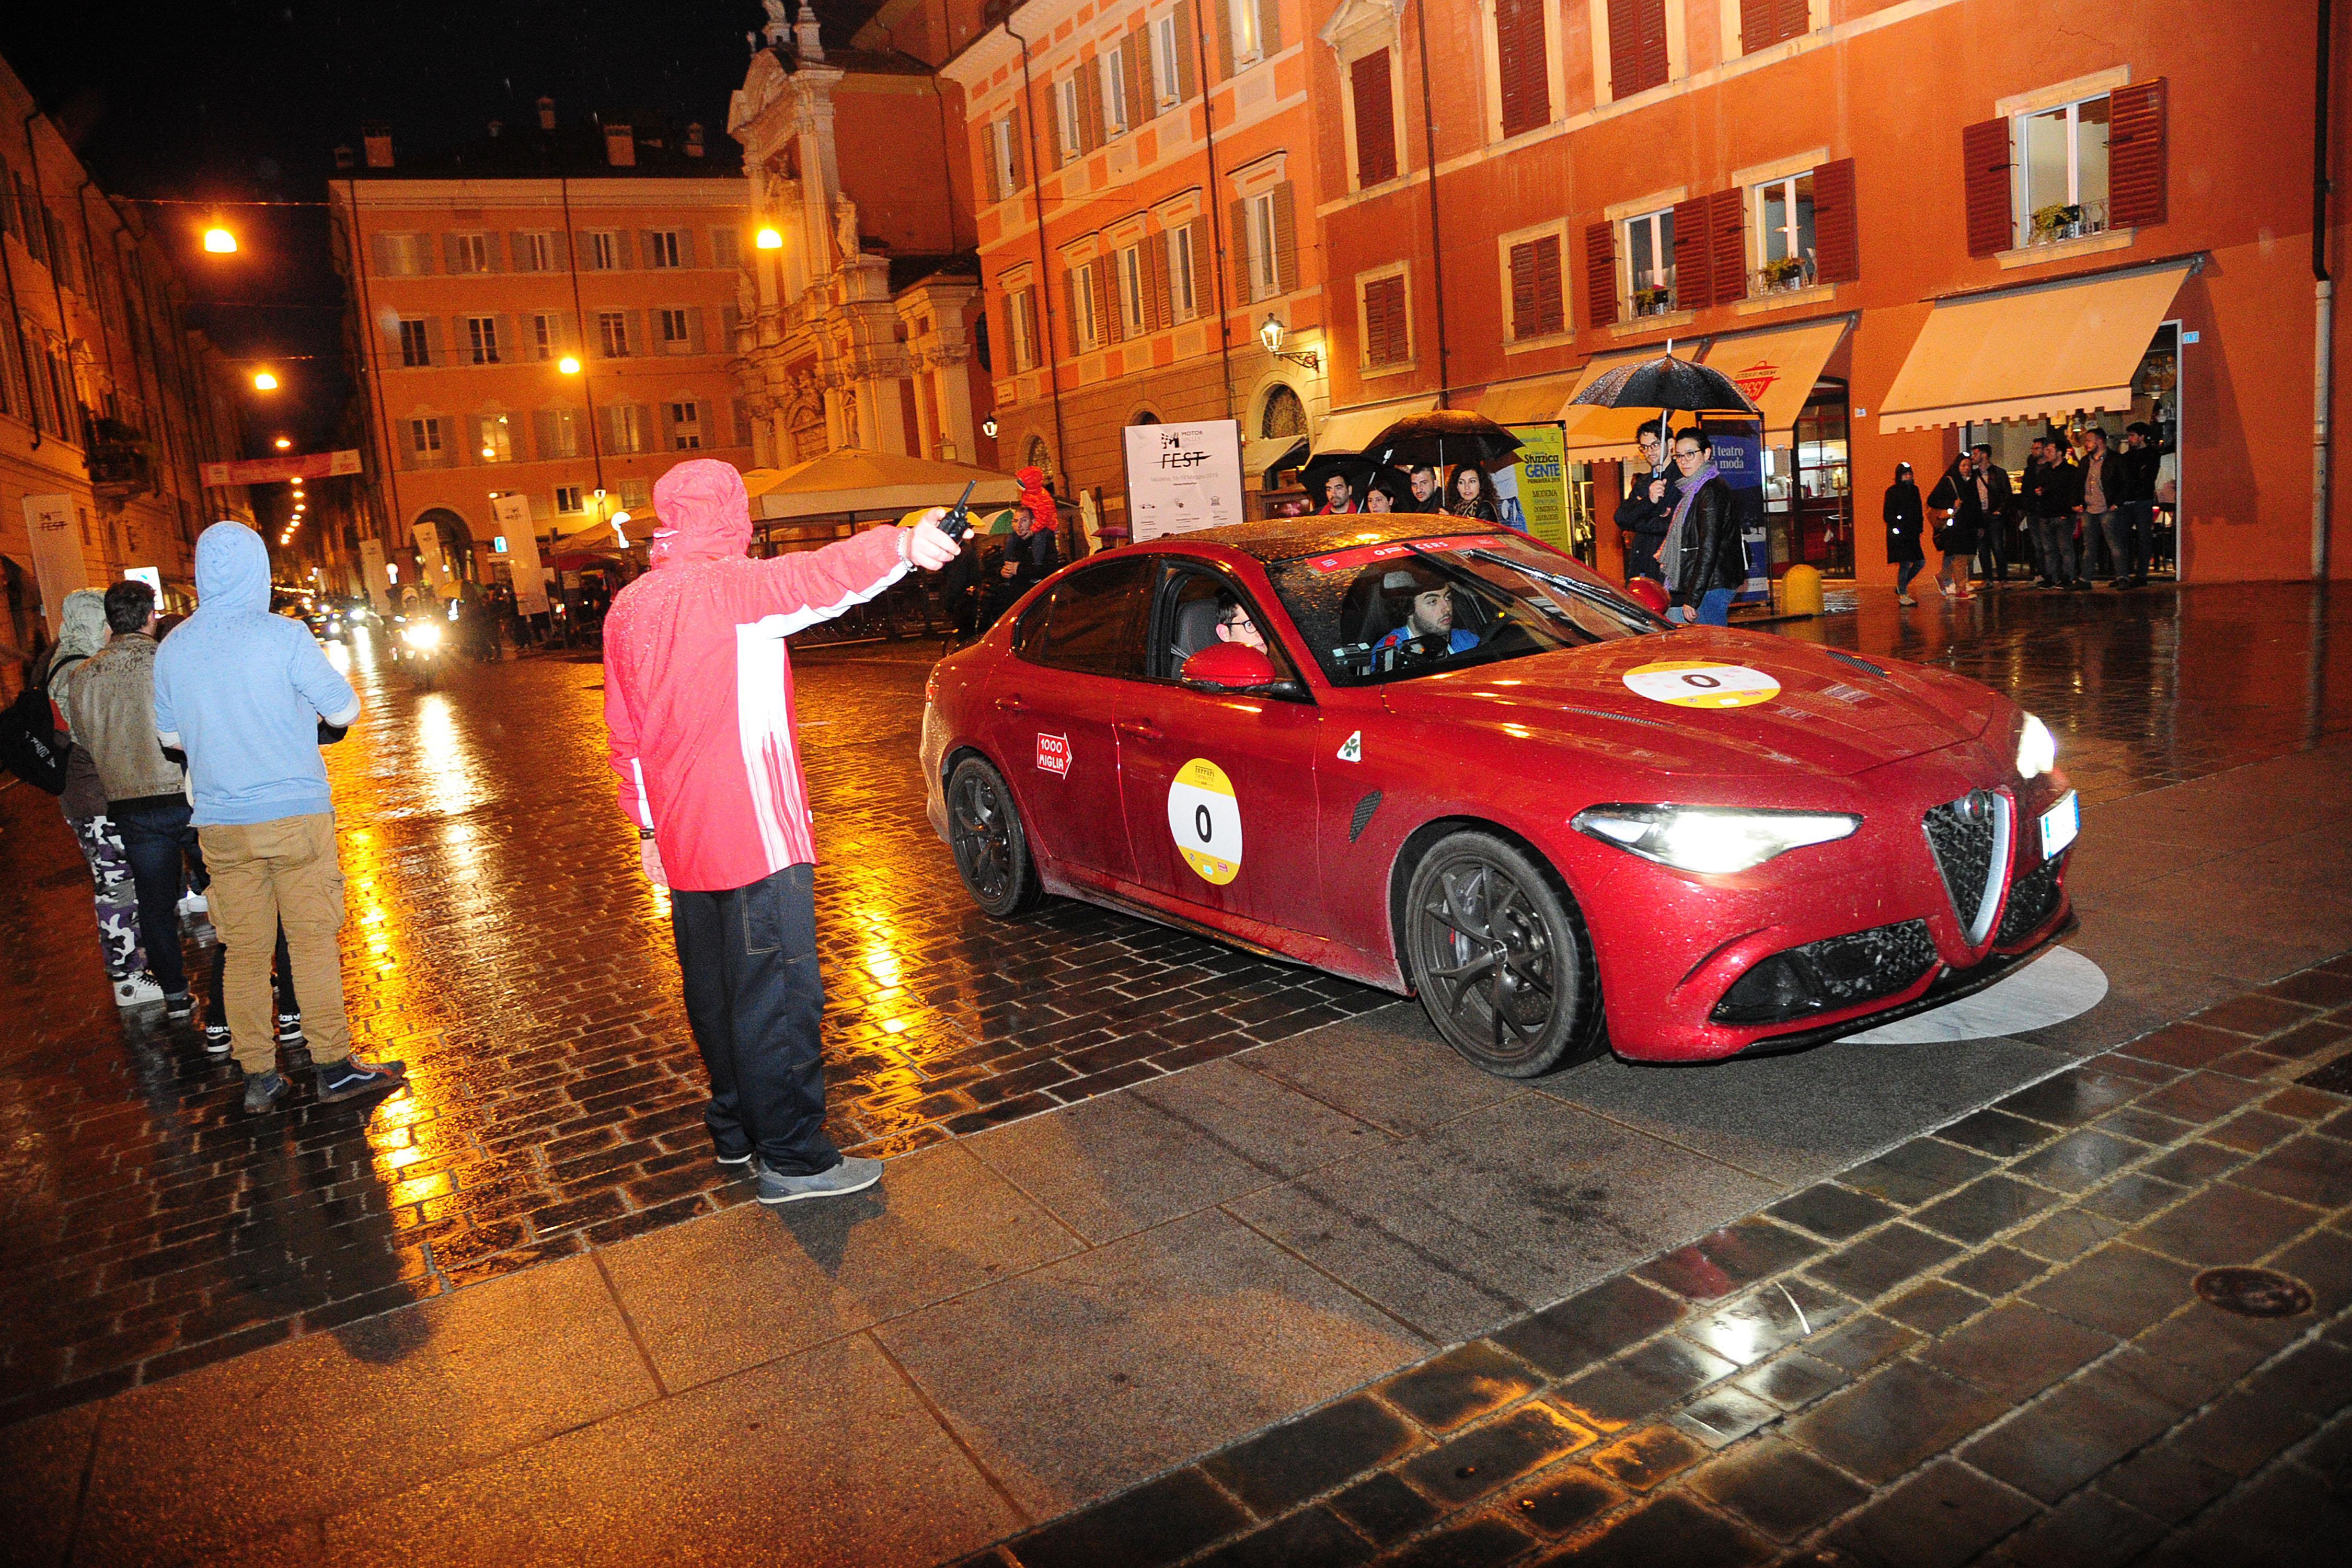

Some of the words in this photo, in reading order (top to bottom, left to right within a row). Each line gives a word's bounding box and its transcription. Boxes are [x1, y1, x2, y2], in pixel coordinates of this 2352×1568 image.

[1739, 381, 1766, 397] OSSI
[1524, 453, 1559, 464] Stuzzica
[1717, 445, 1744, 457] teatro
[1162, 451, 1204, 469] FEST
[1720, 457, 1744, 469] moda
[1525, 463, 1561, 478] GENTE
[1681, 674, 1721, 688] 0
[1041, 738, 1063, 754] 1000
[1039, 753, 1064, 771] MIGLIA
[1195, 804, 1212, 843] 0
